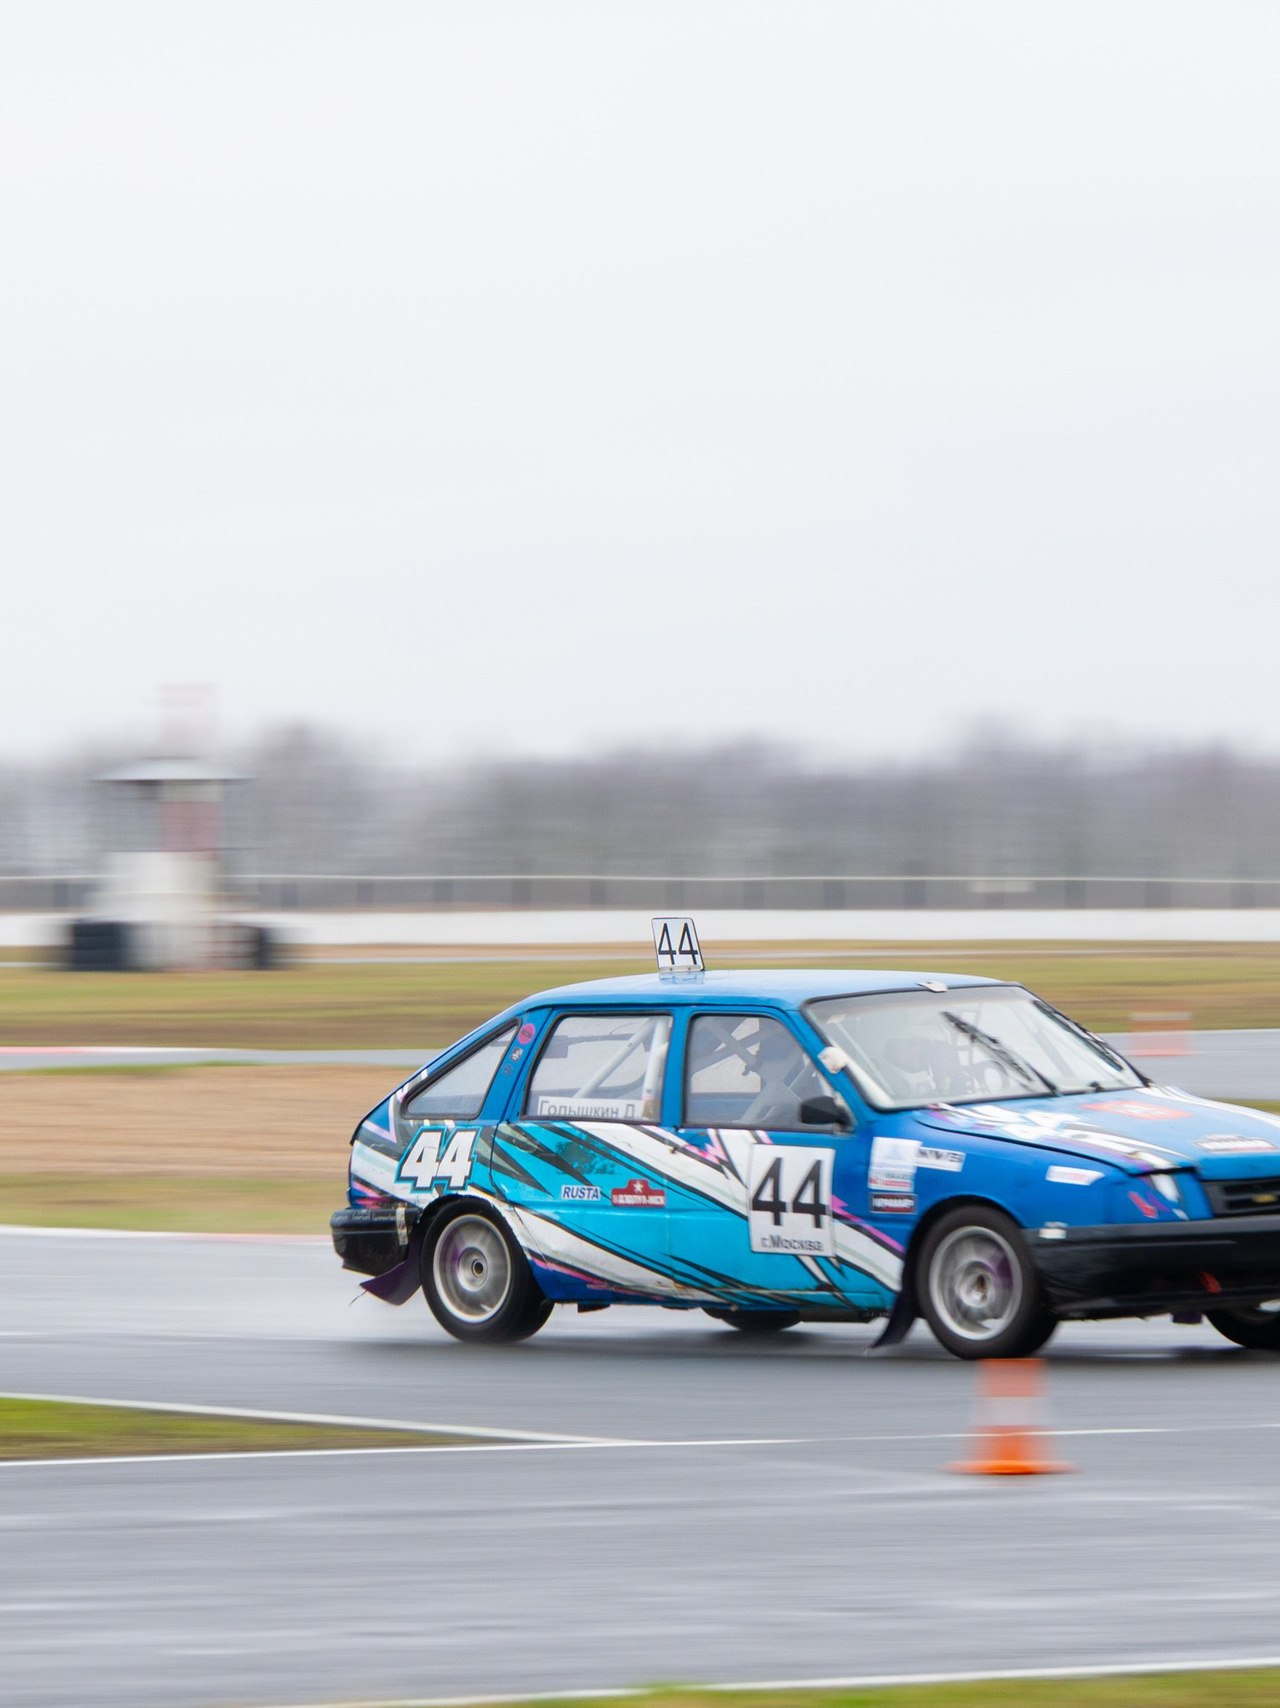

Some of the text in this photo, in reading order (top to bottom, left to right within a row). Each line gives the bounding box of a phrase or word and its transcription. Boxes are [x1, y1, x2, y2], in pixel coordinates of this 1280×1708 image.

[658, 922, 699, 966] 44
[398, 1128, 480, 1191] 44
[562, 1185, 600, 1200] RUSTA
[751, 1156, 828, 1229] 44
